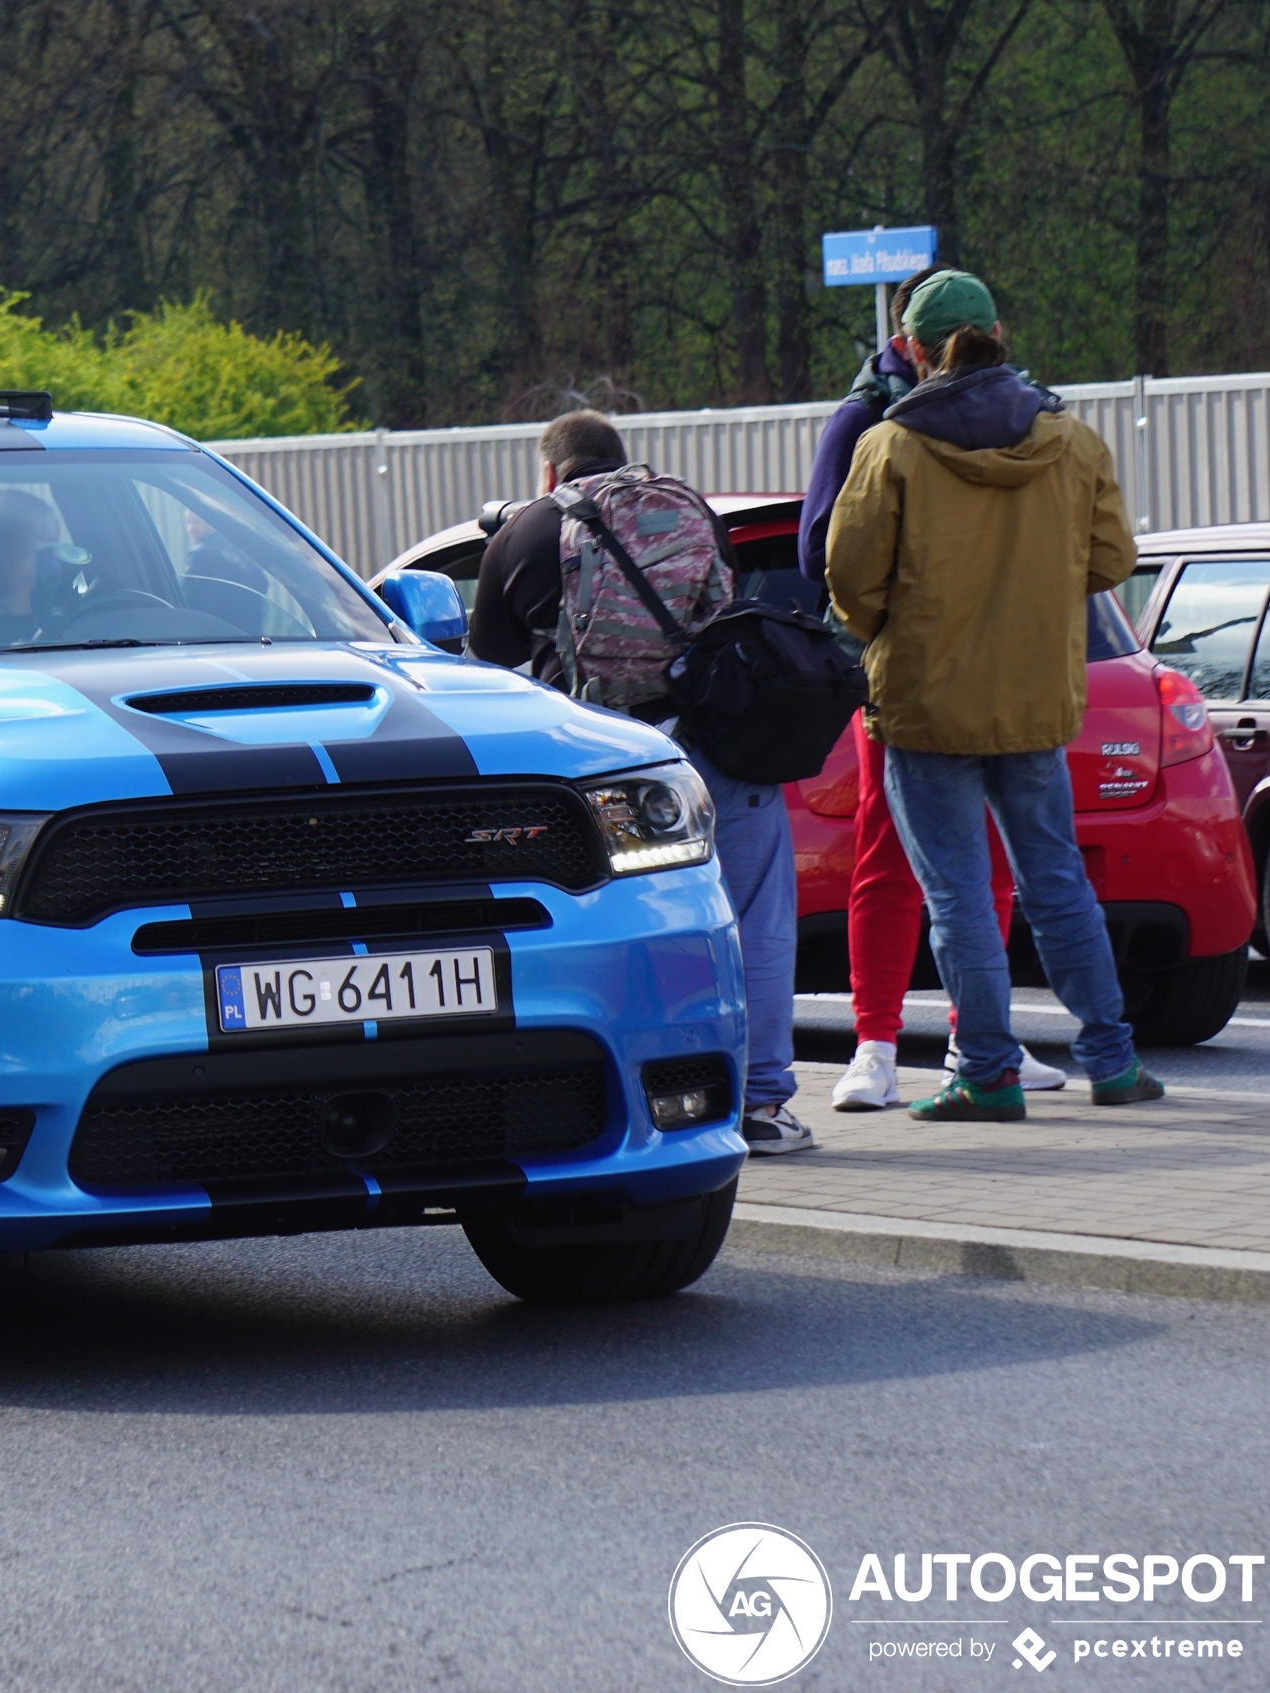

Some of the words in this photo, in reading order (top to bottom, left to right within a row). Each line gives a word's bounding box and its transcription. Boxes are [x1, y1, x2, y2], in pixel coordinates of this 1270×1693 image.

[464, 826, 548, 846] SRT
[253, 969, 316, 1020] WG
[337, 956, 483, 1013] 6411H
[225, 1005, 242, 1020] PL
